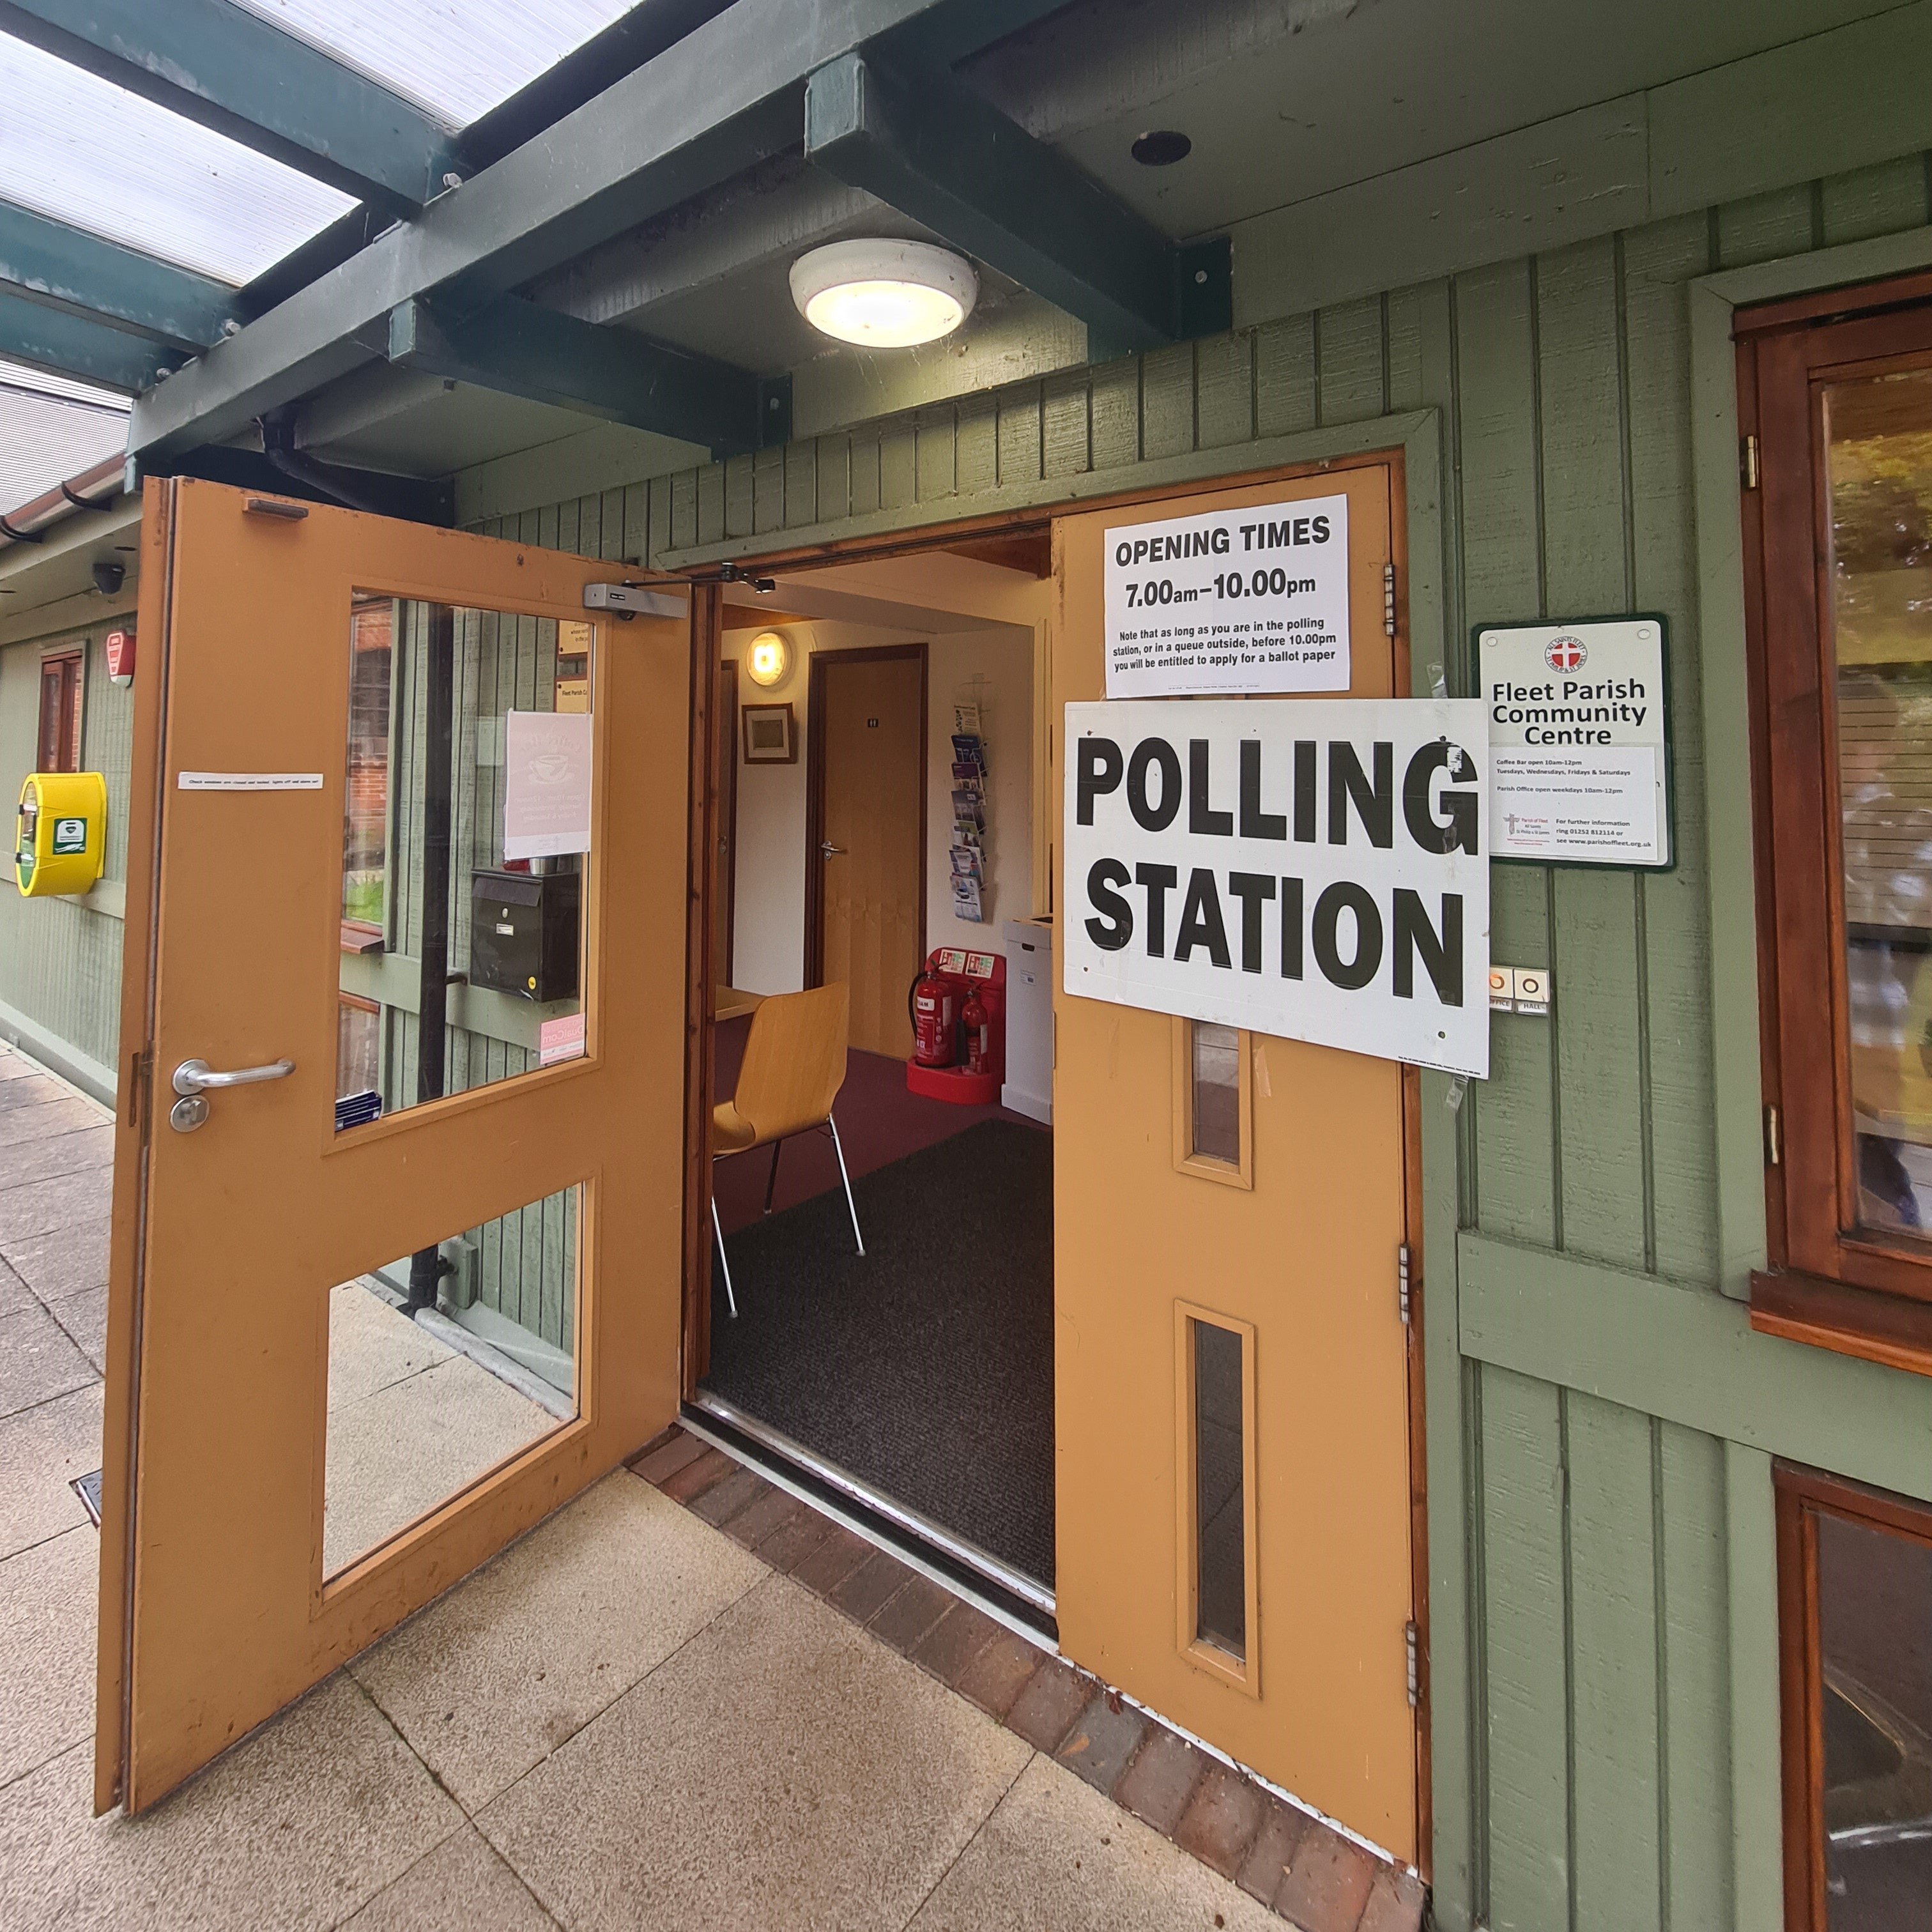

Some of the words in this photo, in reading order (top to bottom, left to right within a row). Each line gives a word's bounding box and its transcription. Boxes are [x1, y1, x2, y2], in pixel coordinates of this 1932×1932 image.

[1116, 528, 1229, 567] OPENING
[1239, 516, 1330, 551] TIMES
[1119, 630, 1138, 642] Note
[1140, 628, 1158, 640] that
[1161, 628, 1172, 637] as
[1174, 625, 1195, 639] long
[1197, 625, 1209, 634] as
[1211, 624, 1230, 636] you
[1232, 624, 1250, 632] are
[1254, 621, 1263, 631] in
[1266, 620, 1284, 631] the
[1287, 617, 1324, 632] polling
[1113, 643, 1141, 657] station,
[1144, 645, 1153, 654] or
[1155, 642, 1164, 652] in
[1167, 643, 1173, 652] a
[1176, 640, 1204, 654] queue
[1207, 636, 1248, 650] outside,
[1252, 634, 1285, 647] before
[1289, 632, 1336, 648] 10.00pm
[1115, 661, 1128, 673] you
[1130, 659, 1143, 670] will
[1146, 657, 1156, 668] be
[1158, 655, 1193, 668] entitled
[1197, 654, 1207, 664] to
[1209, 652, 1237, 666] apply
[1240, 651, 1255, 663] for
[1259, 654, 1265, 662] a
[1268, 649, 1300, 662] ballot
[1303, 650, 1335, 664] paper
[1493, 682, 1554, 702] Fleet
[1563, 679, 1645, 701] Parish
[1492, 703, 1646, 726] Community
[1525, 726, 1611, 745] Centre
[1077, 737, 1478, 855] POLLING
[1568, 838, 1651, 848] www.parishoffleet.org.uk
[1084, 857, 1463, 1008] STATION
